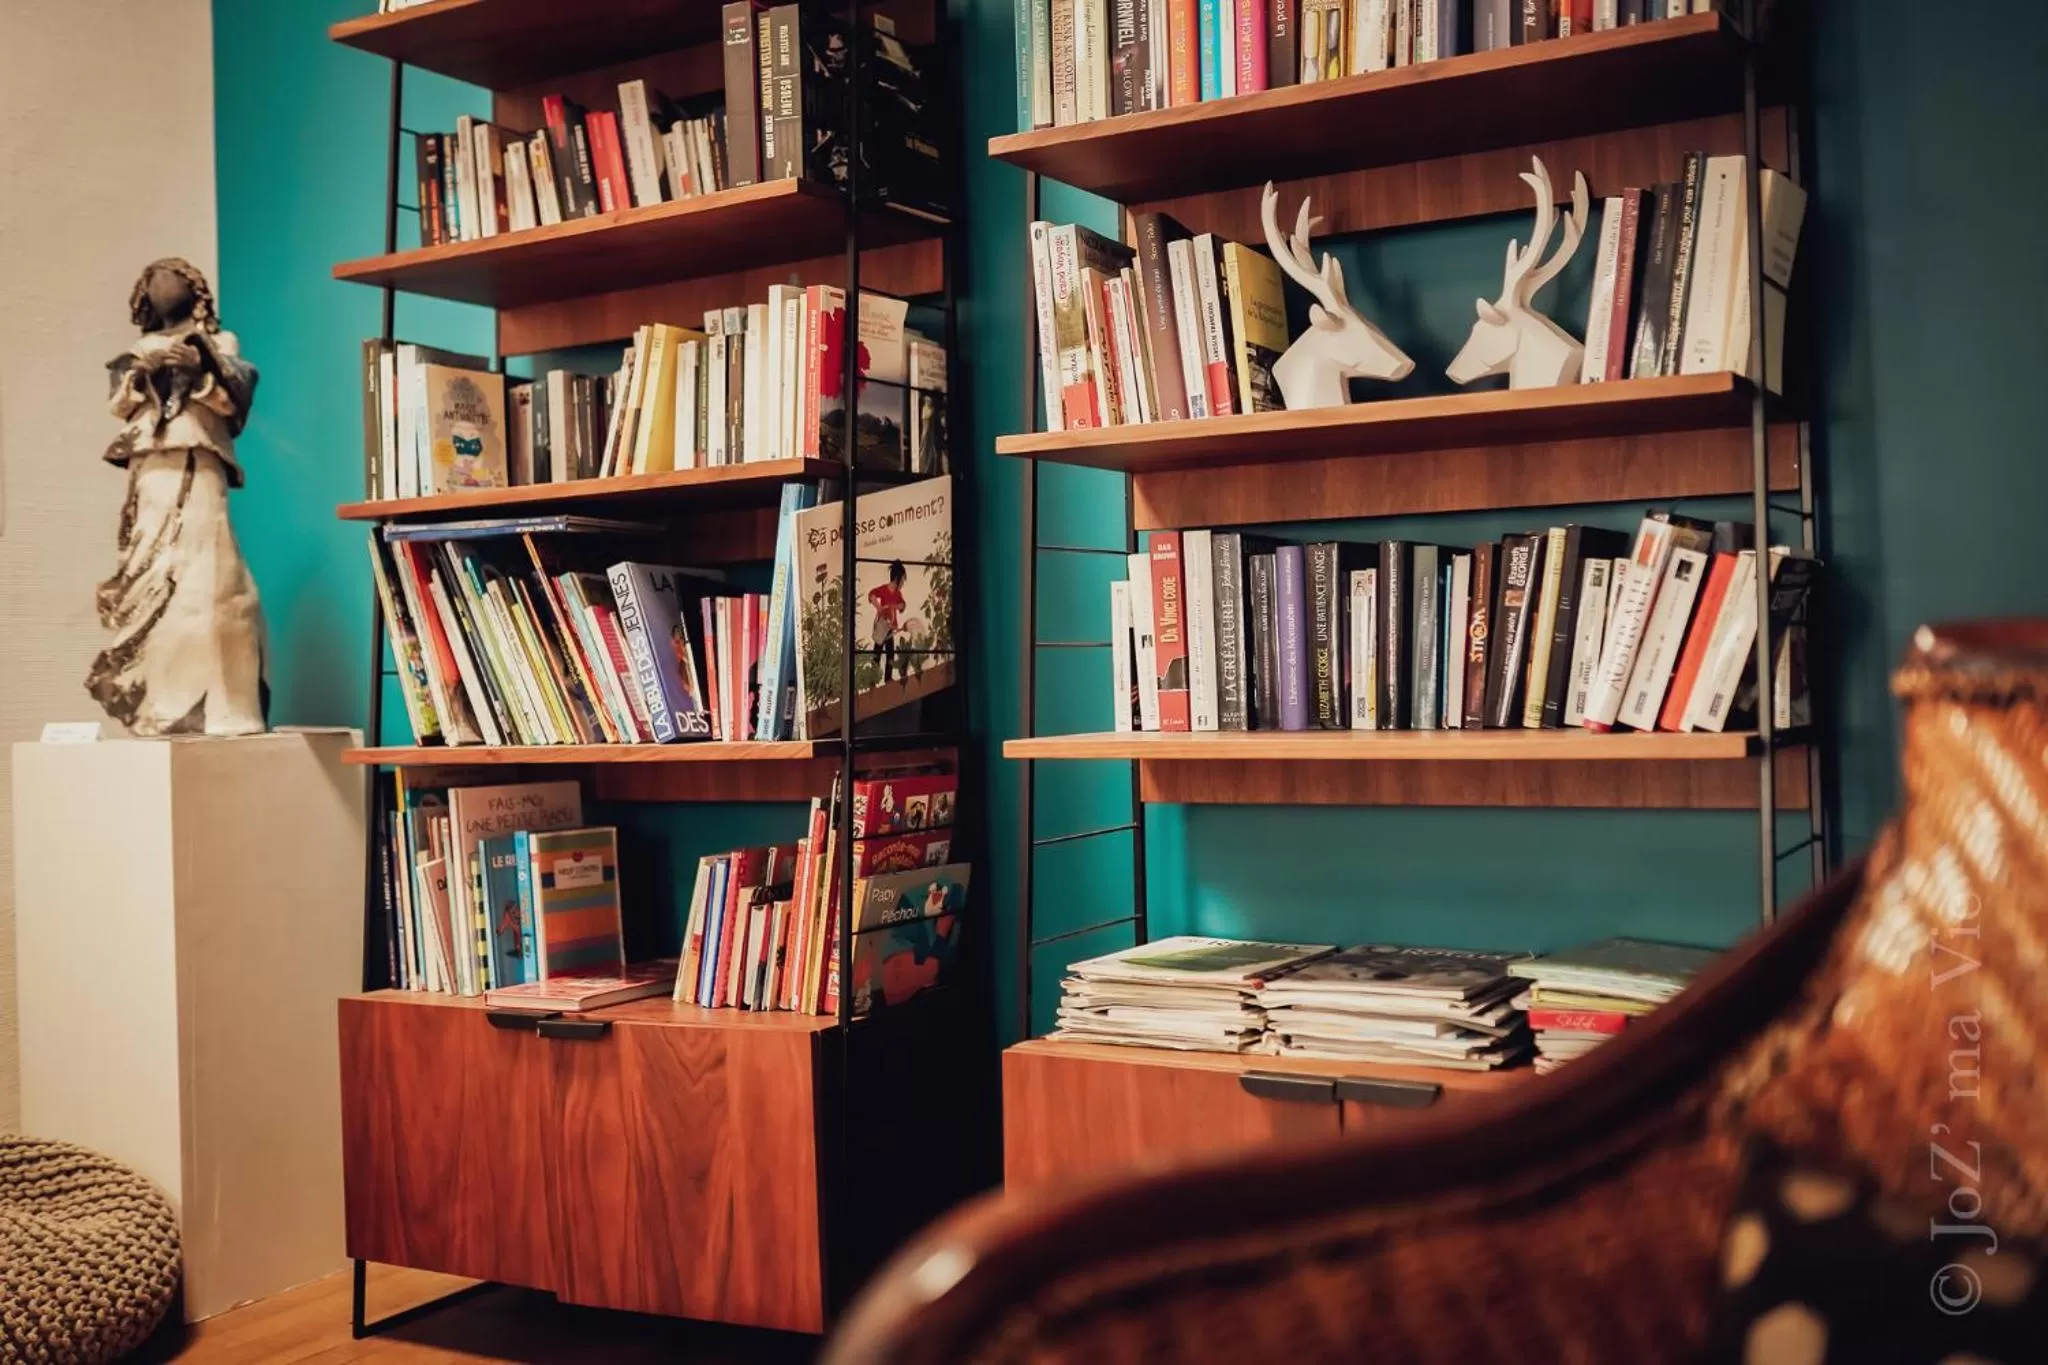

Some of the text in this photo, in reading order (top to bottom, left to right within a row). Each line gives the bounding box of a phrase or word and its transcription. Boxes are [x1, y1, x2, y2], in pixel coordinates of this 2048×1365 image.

[1275, 23, 1285, 37] La
[1123, 68, 1133, 99] BLOW
[1686, 157, 1698, 187] victoire
[1685, 188, 1694, 203] une
[1682, 205, 1693, 224] pour
[831, 517, 876, 547] posse
[878, 494, 946, 530] comment?
[1152, 550, 1178, 561] BROWN
[1156, 542, 1173, 552] DAN
[1507, 546, 1521, 585] Elizabeth
[1517, 546, 1529, 586] GEORGE
[649, 570, 675, 592] LA
[1160, 576, 1177, 599] CODE
[611, 571, 641, 632] JEUNES
[1314, 550, 1328, 641] UNE PATIENCE D'ANGE
[633, 634, 653, 671] DES
[1218, 599, 1236, 681] CRÉATURE
[1225, 681, 1237, 702] LA
[1317, 647, 1330, 719] ELIZABETH GEORGE
[654, 711, 673, 740] LA
[675, 709, 711, 734] DES
[466, 817, 495, 833] UNE
[493, 855, 505, 869] LE
